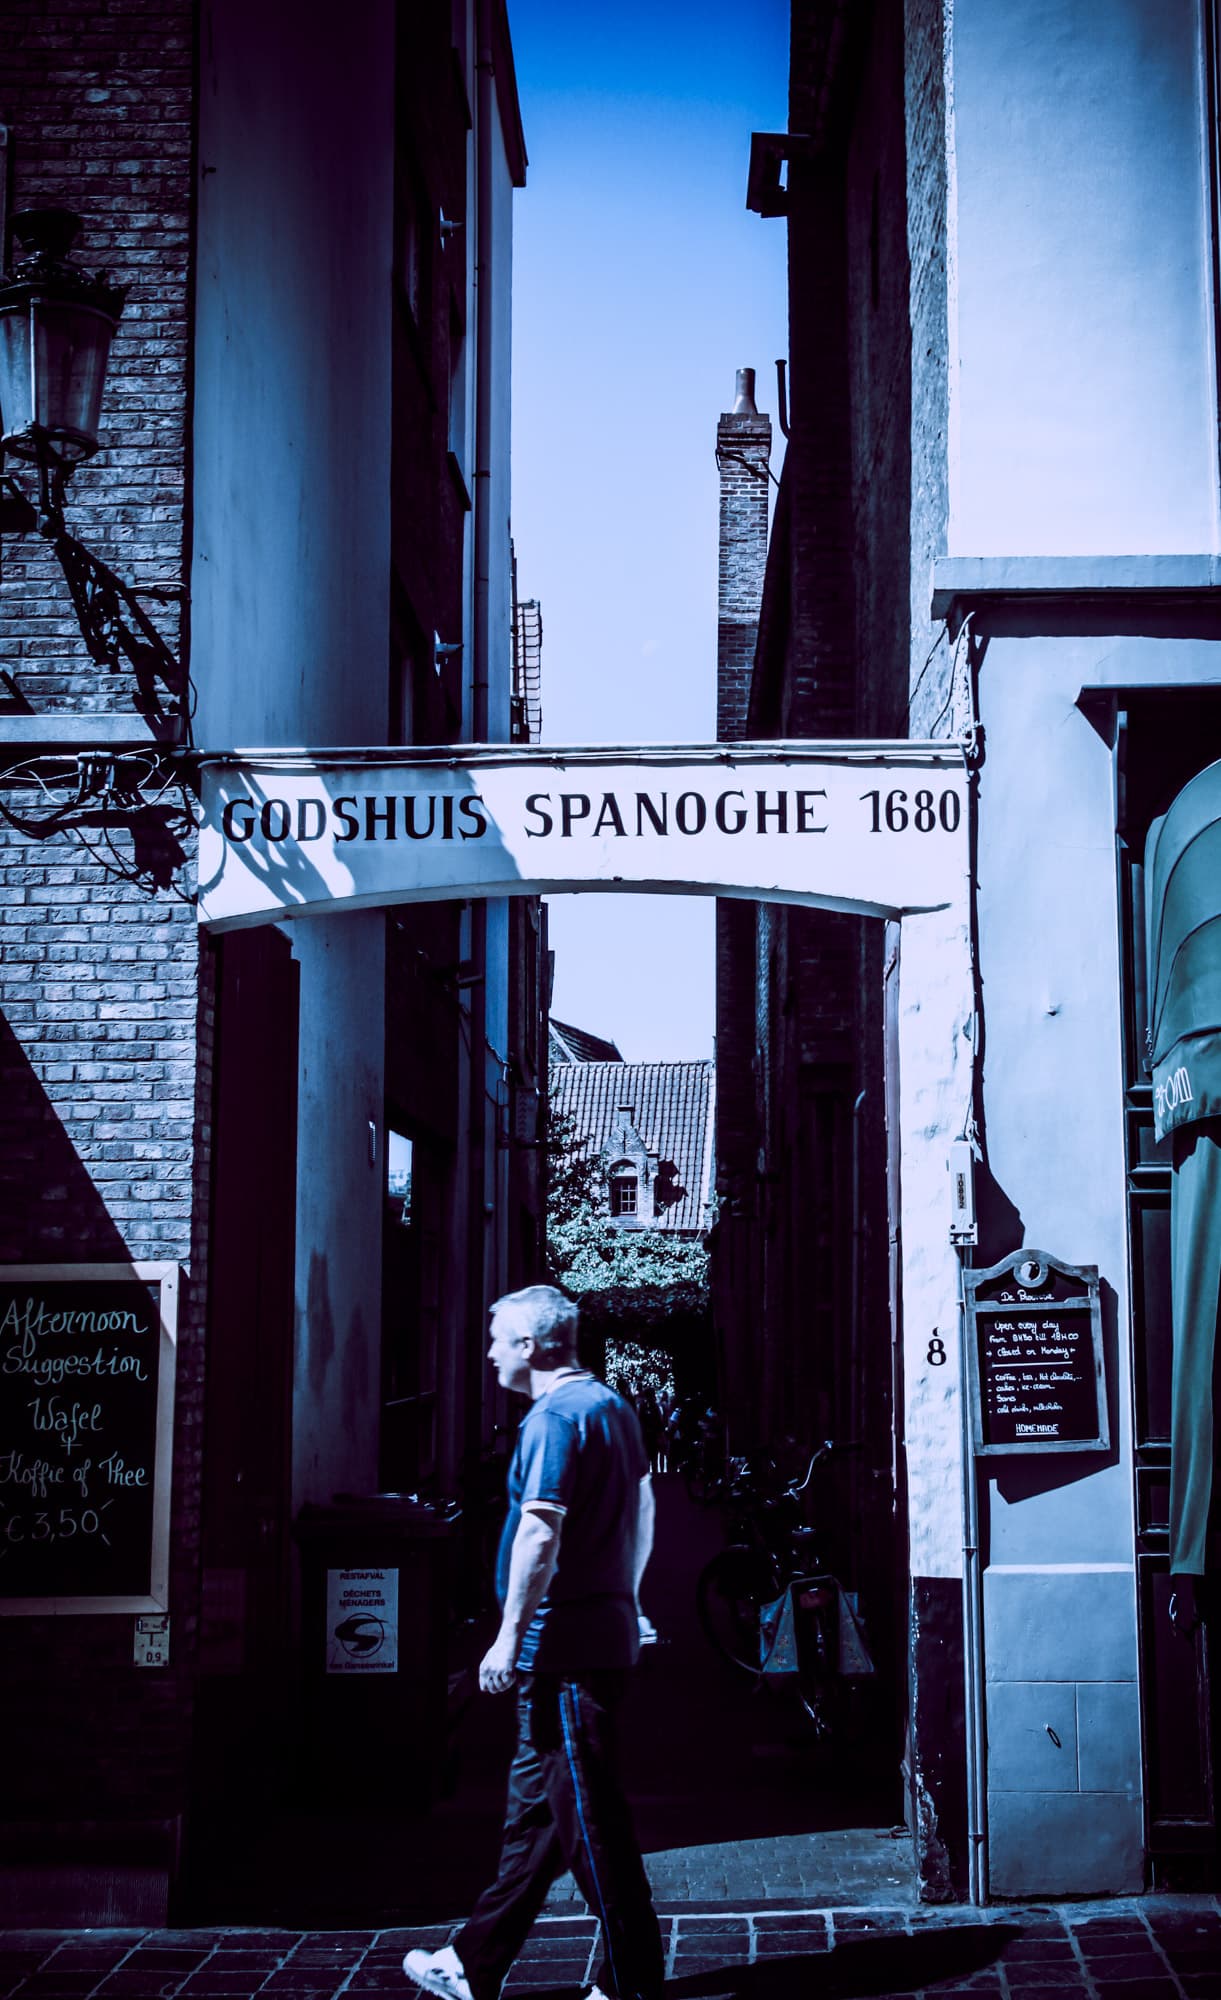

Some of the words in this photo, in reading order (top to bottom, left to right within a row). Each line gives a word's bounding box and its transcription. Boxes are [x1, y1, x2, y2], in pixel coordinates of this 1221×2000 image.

[222, 794, 488, 844] GODSHUIS
[523, 789, 829, 839] SPANOGHE
[858, 788, 961, 834] 1680
[0, 1298, 148, 1358] Afternoon
[1042, 1320, 1059, 1333] day
[2, 1346, 148, 1386] Suggestion
[927, 1339, 947, 1366] 8
[1041, 1346, 1069, 1359] Monday
[27, 1396, 103, 1443] Wafel
[1015, 1424, 1059, 1434] HOMEMADE
[0, 1450, 64, 1498] Koffie
[72, 1458, 91, 1498] of
[98, 1451, 149, 1487] Thee
